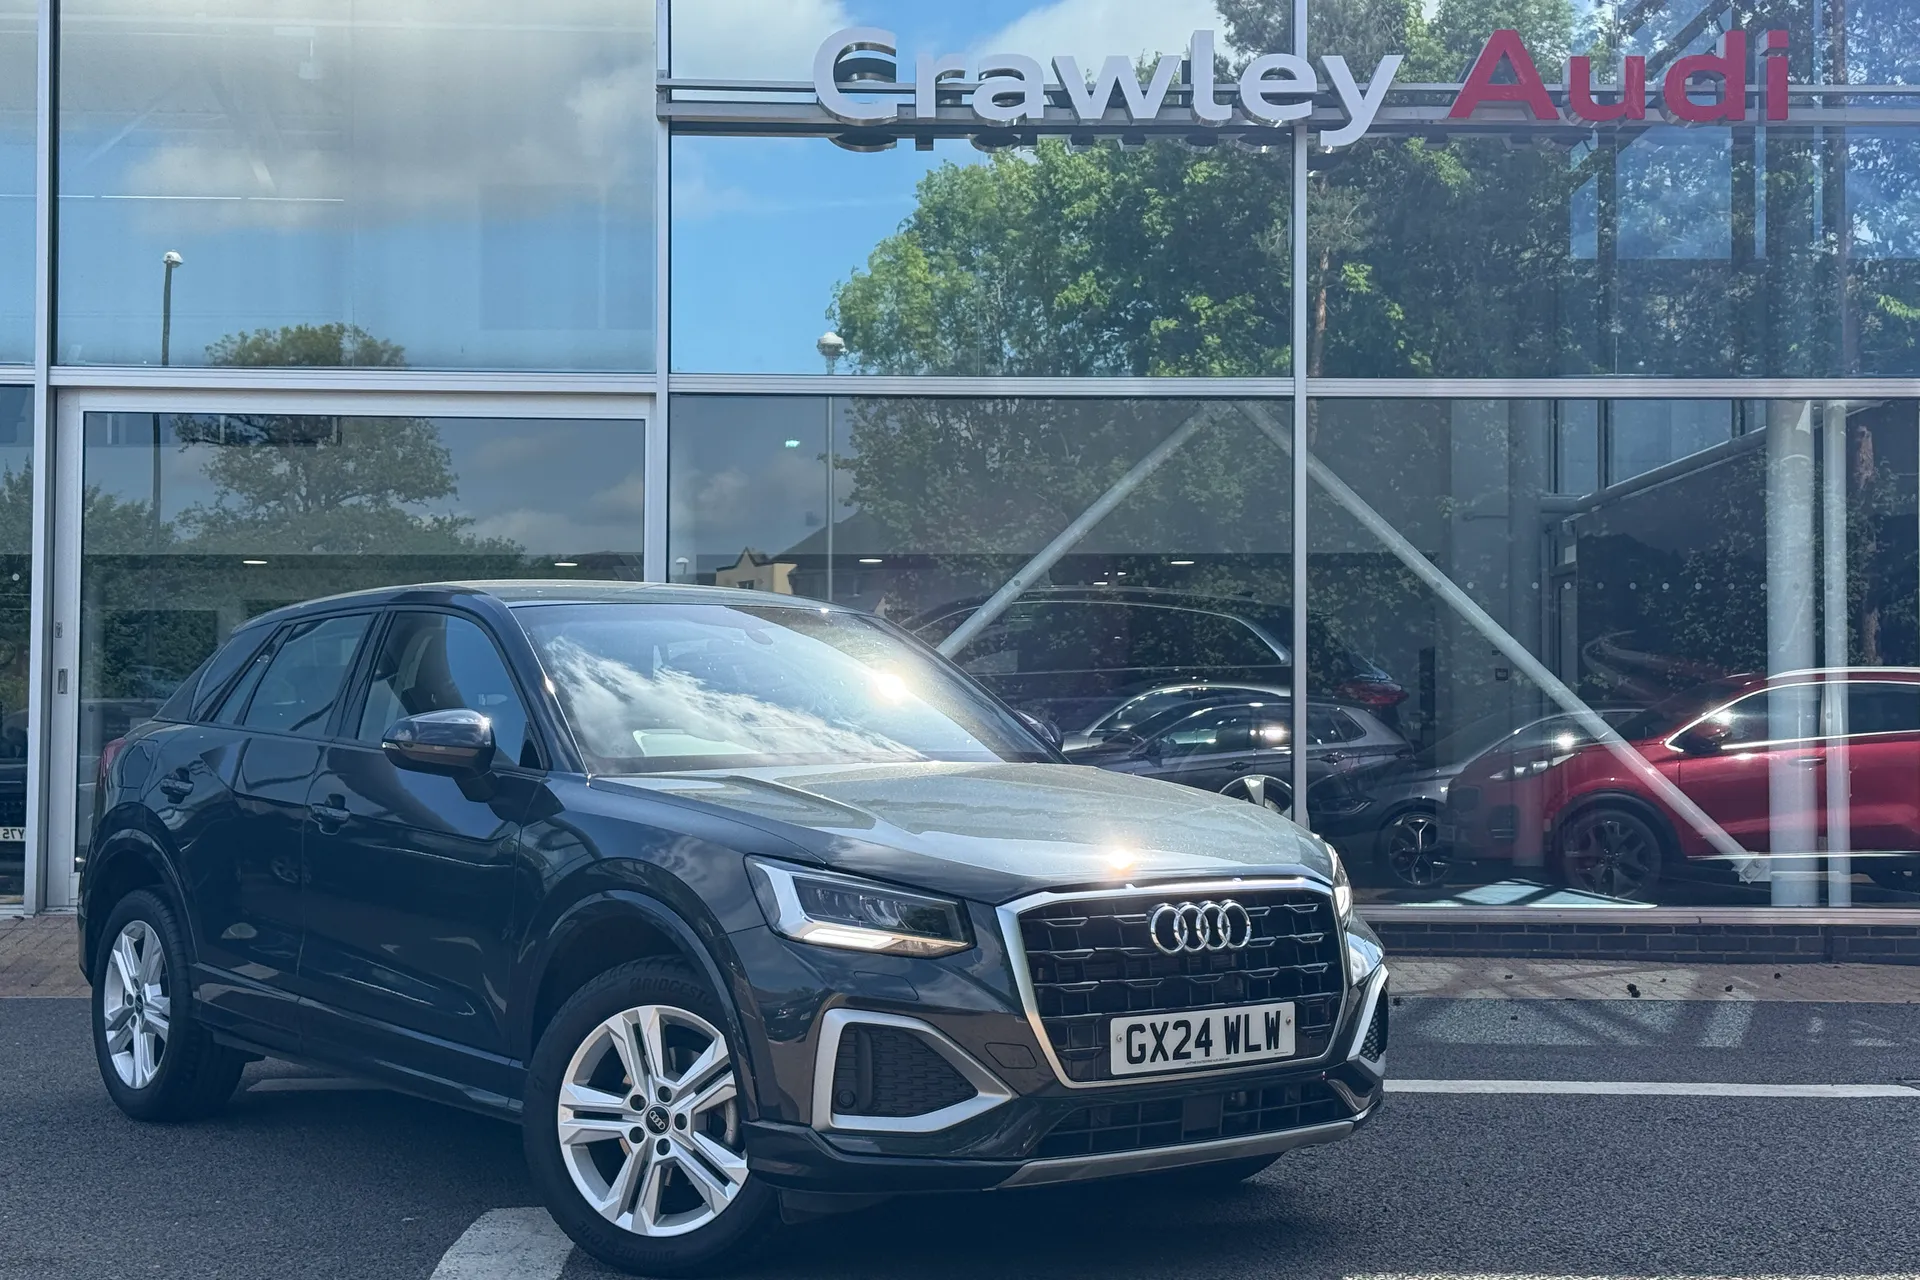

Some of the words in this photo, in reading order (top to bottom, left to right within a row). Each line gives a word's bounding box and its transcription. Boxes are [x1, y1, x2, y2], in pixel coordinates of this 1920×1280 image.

[813, 27, 1404, 147] Crawley
[1448, 30, 1789, 121] Audi
[1126, 1018, 1213, 1065] GX24
[1224, 1010, 1281, 1055] WLW
